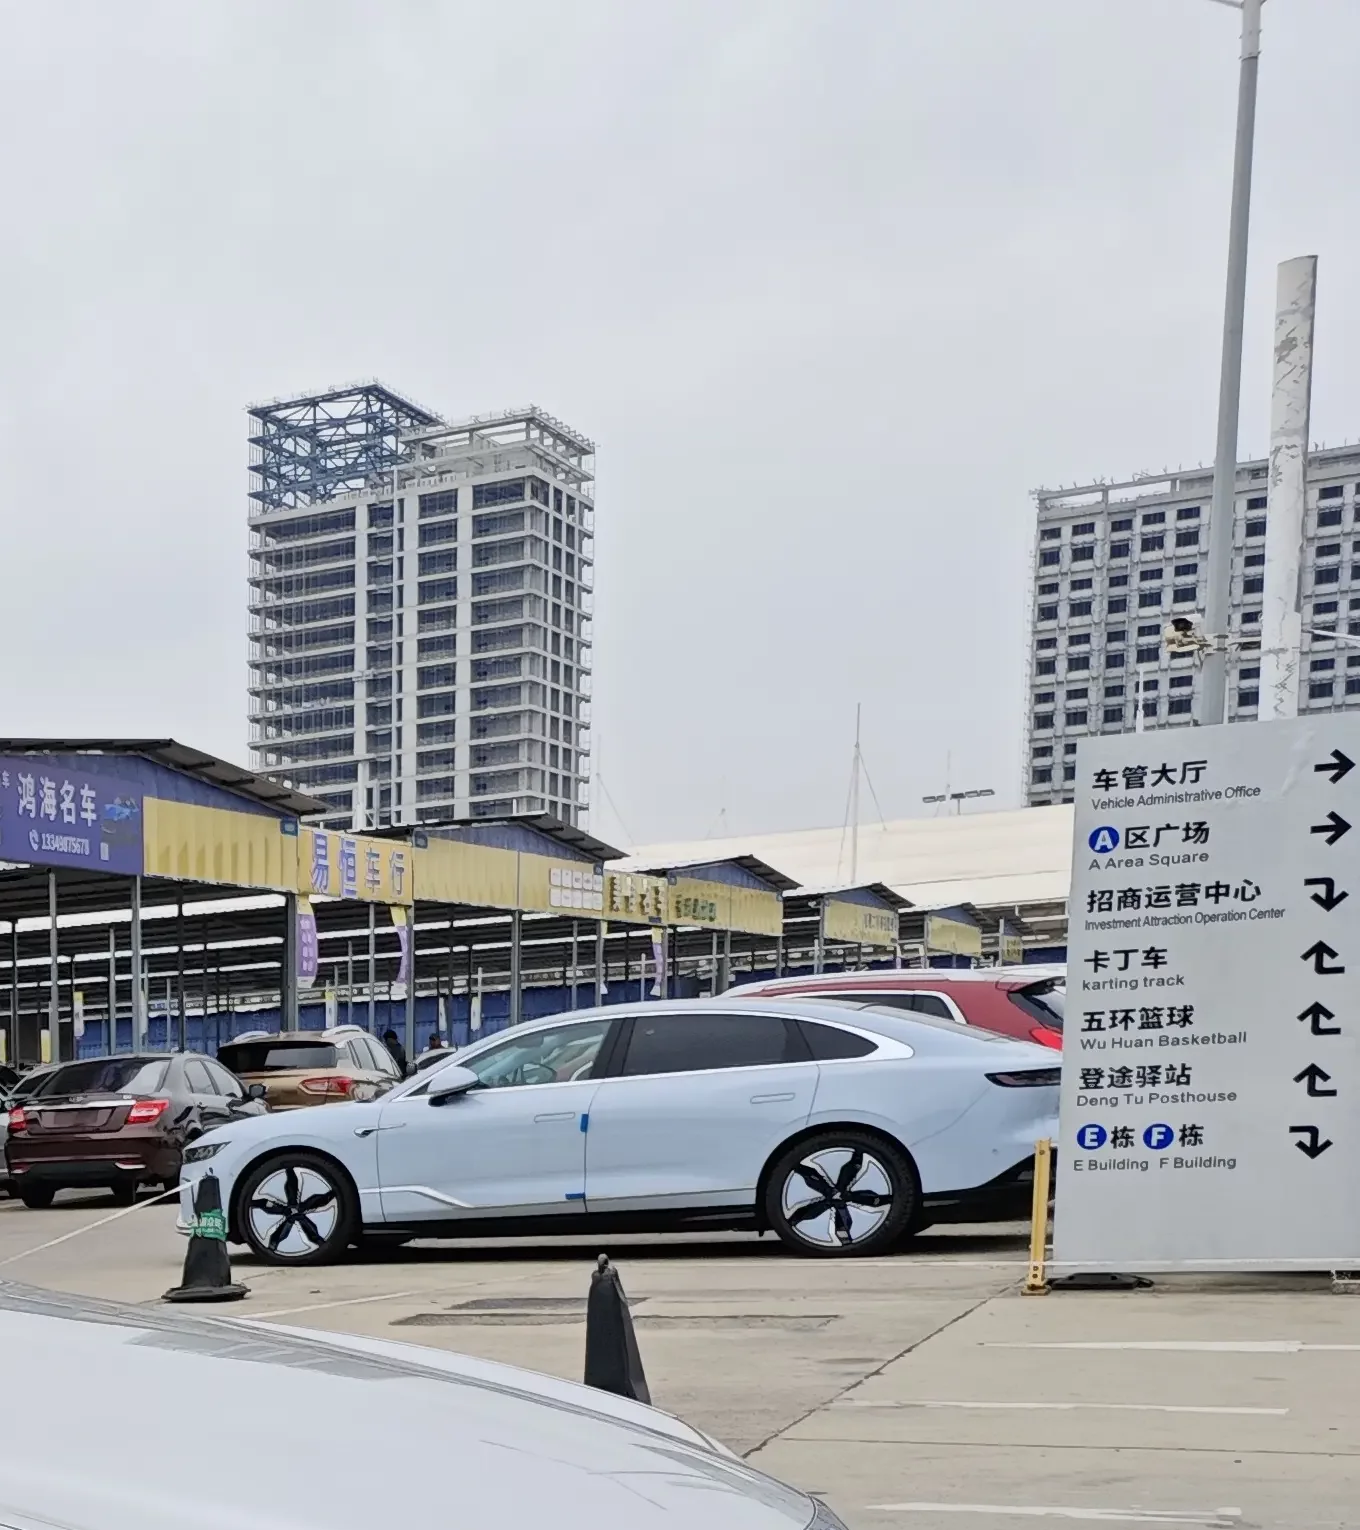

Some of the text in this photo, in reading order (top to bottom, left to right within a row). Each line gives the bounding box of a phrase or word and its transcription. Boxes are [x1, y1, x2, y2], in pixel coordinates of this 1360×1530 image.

[1092, 760, 1208, 791] 车管大厅
[17, 771, 98, 827] 鸿海名车
[1091, 785, 1261, 810] Vehicle Administrative Office
[1088, 852, 1209, 870] A Area Square
[1086, 878, 1262, 913] 招商运营中心
[1085, 906, 1286, 931] Investment Attraction Operation Center
[1083, 946, 1168, 973] 卡丁车
[1082, 974, 1185, 991] karting track
[1080, 1004, 1195, 1032] 五环篮球
[1080, 1031, 1247, 1050] Wu Huan Basketball
[1078, 1063, 1193, 1090] 登途驿站
[1076, 1091, 1238, 1107] Deng Tu Posthouse
[1073, 1156, 1237, 1172] E Building F Building
